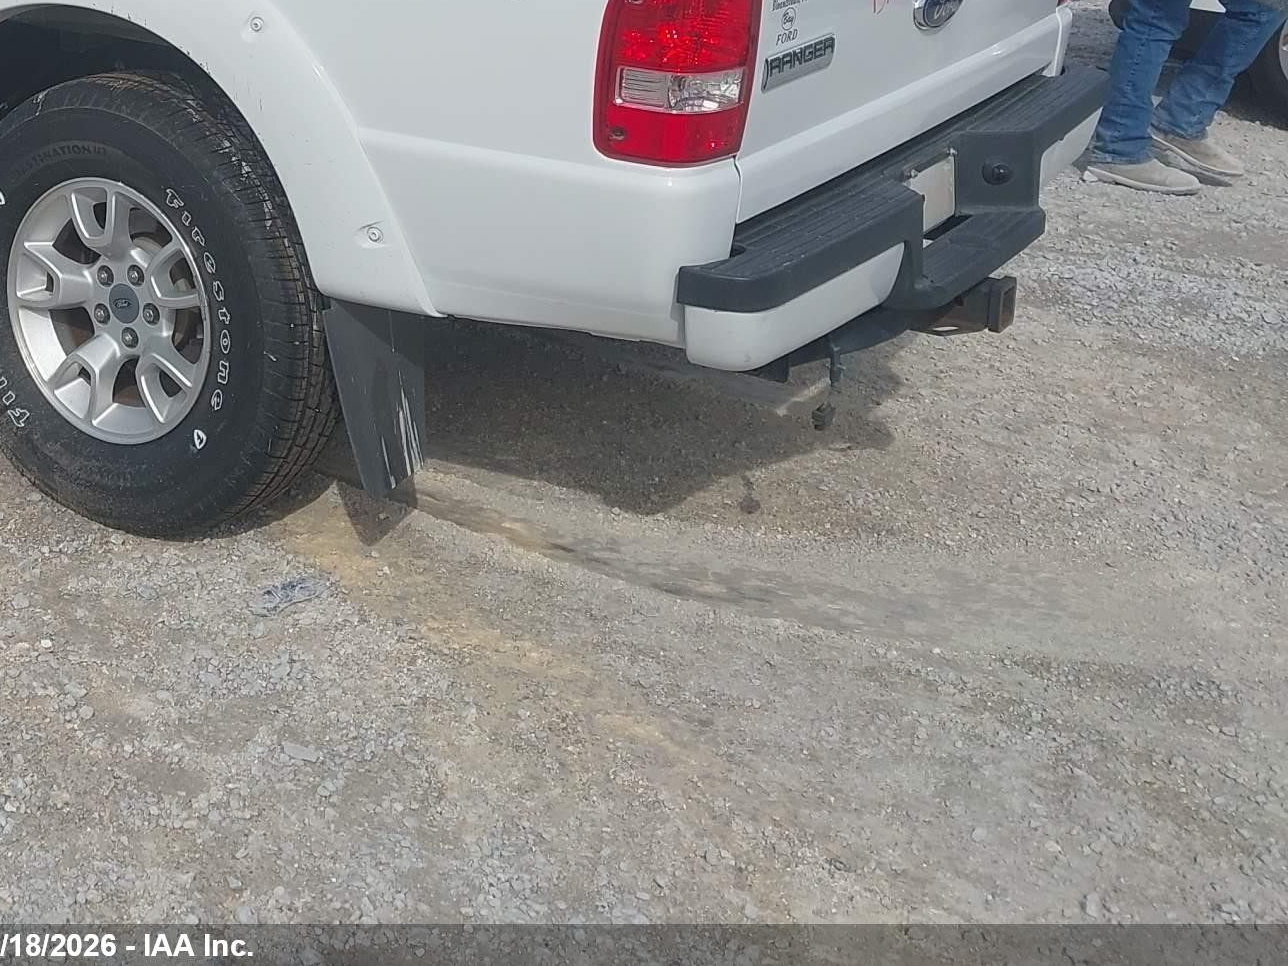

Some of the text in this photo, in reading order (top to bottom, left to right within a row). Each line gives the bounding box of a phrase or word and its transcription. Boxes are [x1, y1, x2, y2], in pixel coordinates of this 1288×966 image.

[769, 36, 836, 77] RANGER
[775, 28, 799, 46] FORD
[165, 188, 232, 412] Firestone
